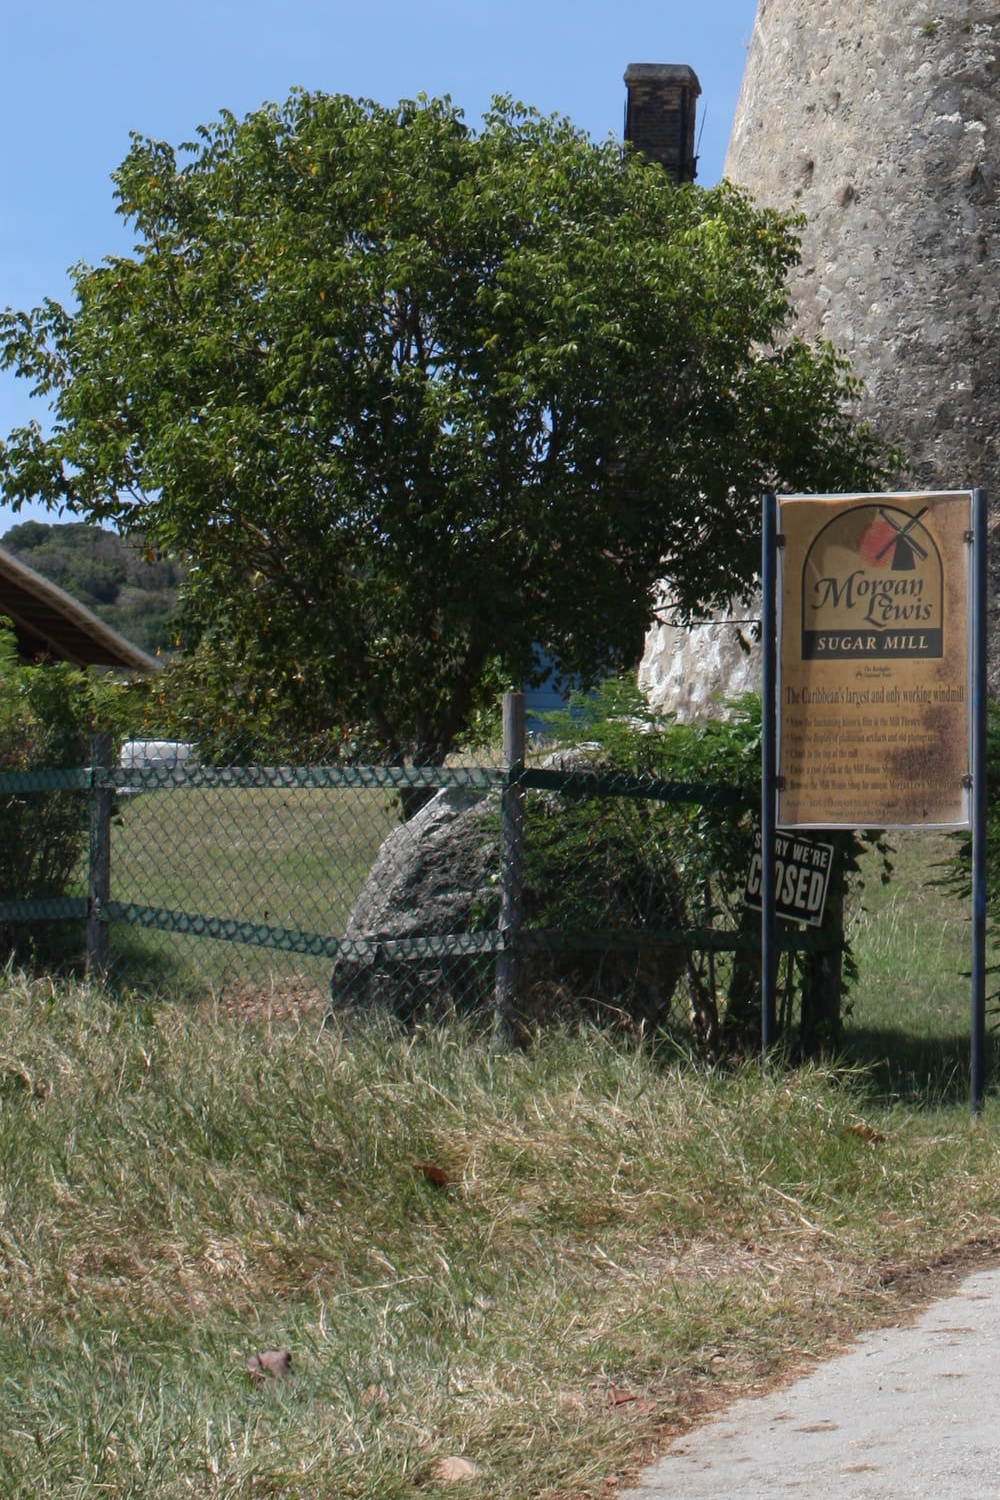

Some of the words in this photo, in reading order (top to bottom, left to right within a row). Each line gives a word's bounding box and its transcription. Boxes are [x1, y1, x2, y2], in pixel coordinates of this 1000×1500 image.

[811, 570, 923, 609] Morgan
[863, 593, 933, 628] Lewis
[817, 636, 877, 651] SUGAR
[884, 635, 929, 649] MILL
[786, 687, 800, 705] The
[802, 687, 845, 705] Caribbean's
[846, 686, 870, 709] largest
[871, 685, 885, 703] and
[886, 685, 901, 708] only
[903, 685, 932, 705] working
[934, 684, 964, 703] windmill
[755, 832, 789, 857] SRY
[793, 843, 829, 868] WE'RE
[747, 854, 825, 912] COSED
